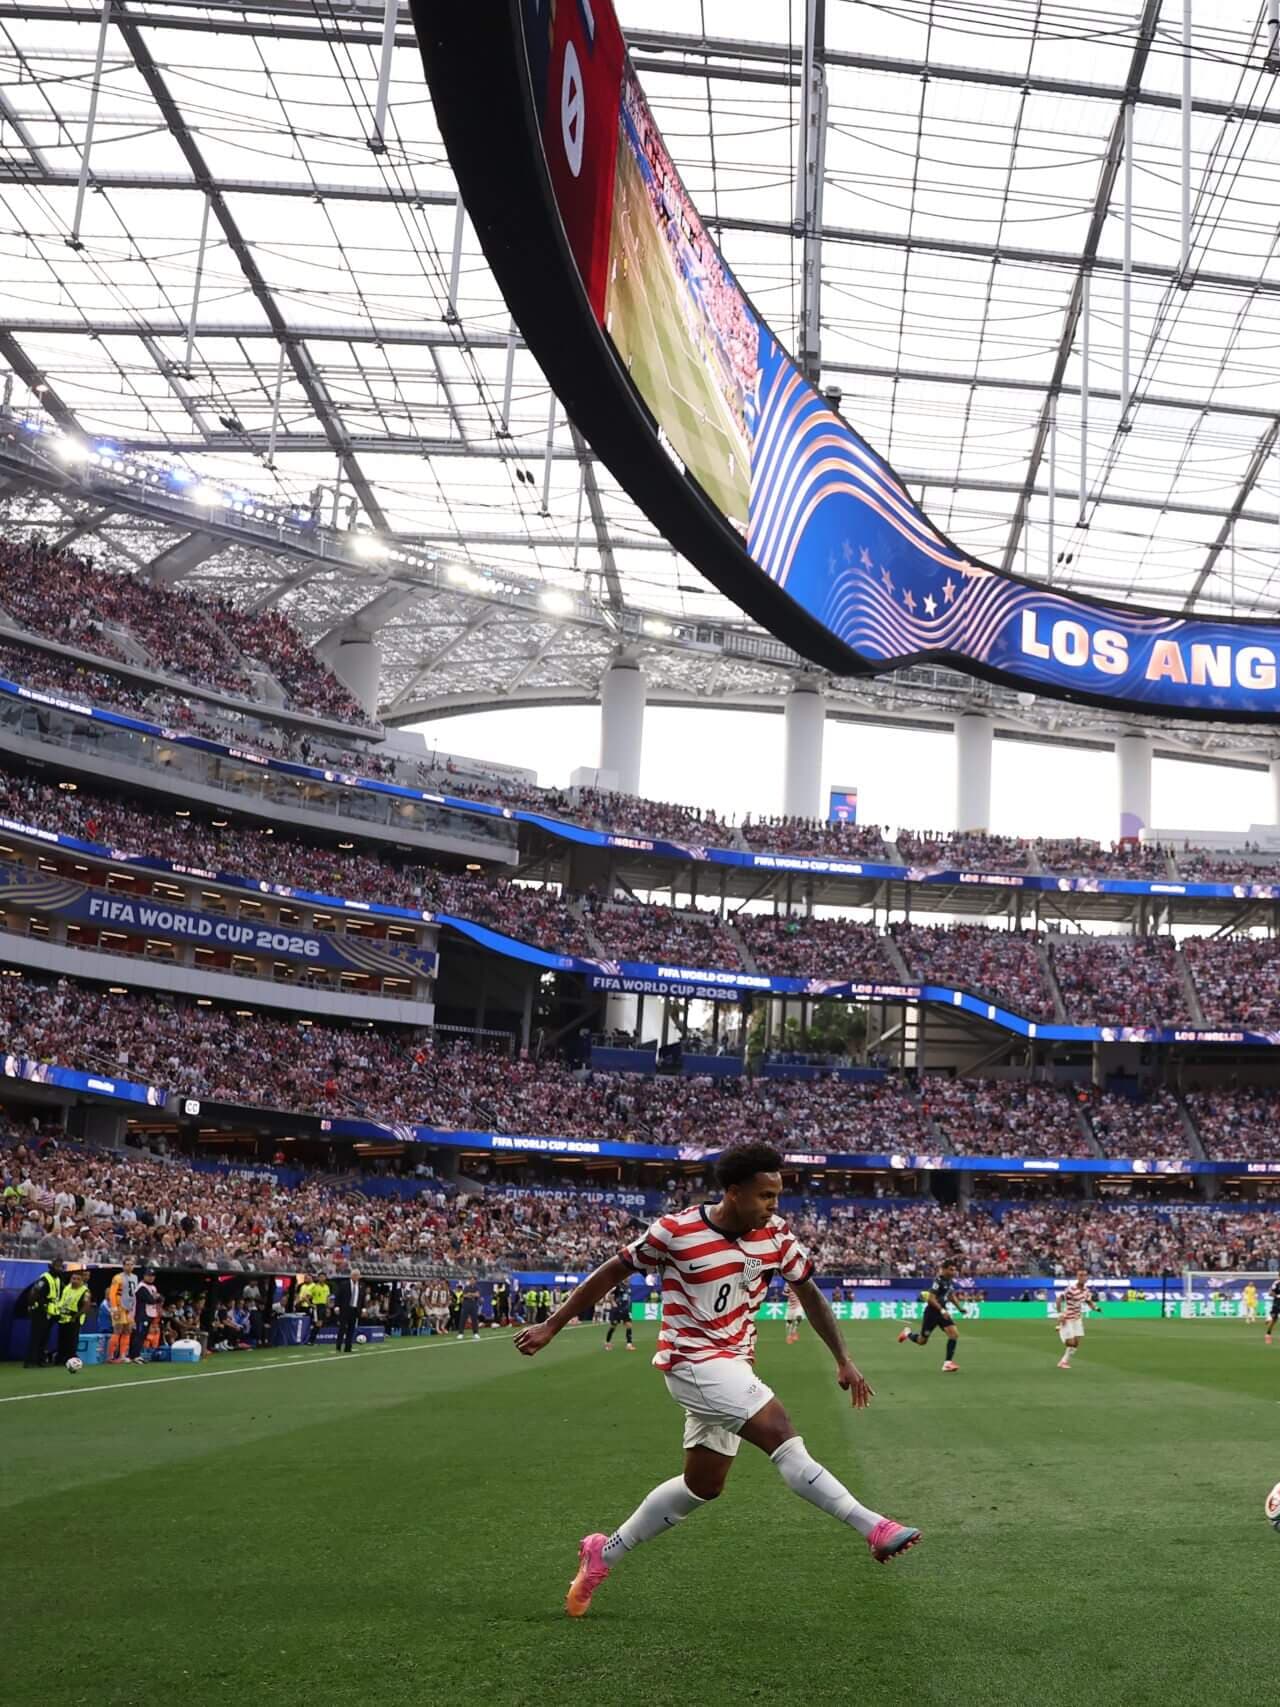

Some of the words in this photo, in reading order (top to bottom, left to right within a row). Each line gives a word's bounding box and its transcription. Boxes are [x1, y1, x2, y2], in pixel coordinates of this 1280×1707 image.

[561, 40, 584, 177] 0
[1021, 609, 1129, 675] LOS
[90, 899, 133, 924] FIFA
[139, 910, 213, 937] WORLD
[215, 924, 254, 944] CUP
[256, 931, 320, 956] 2026
[593, 977, 621, 990] FIFA
[623, 980, 669, 994] WORLD
[670, 984, 695, 996] CUP
[696, 987, 739, 1000] 2026
[714, 1283, 731, 1313] 8
